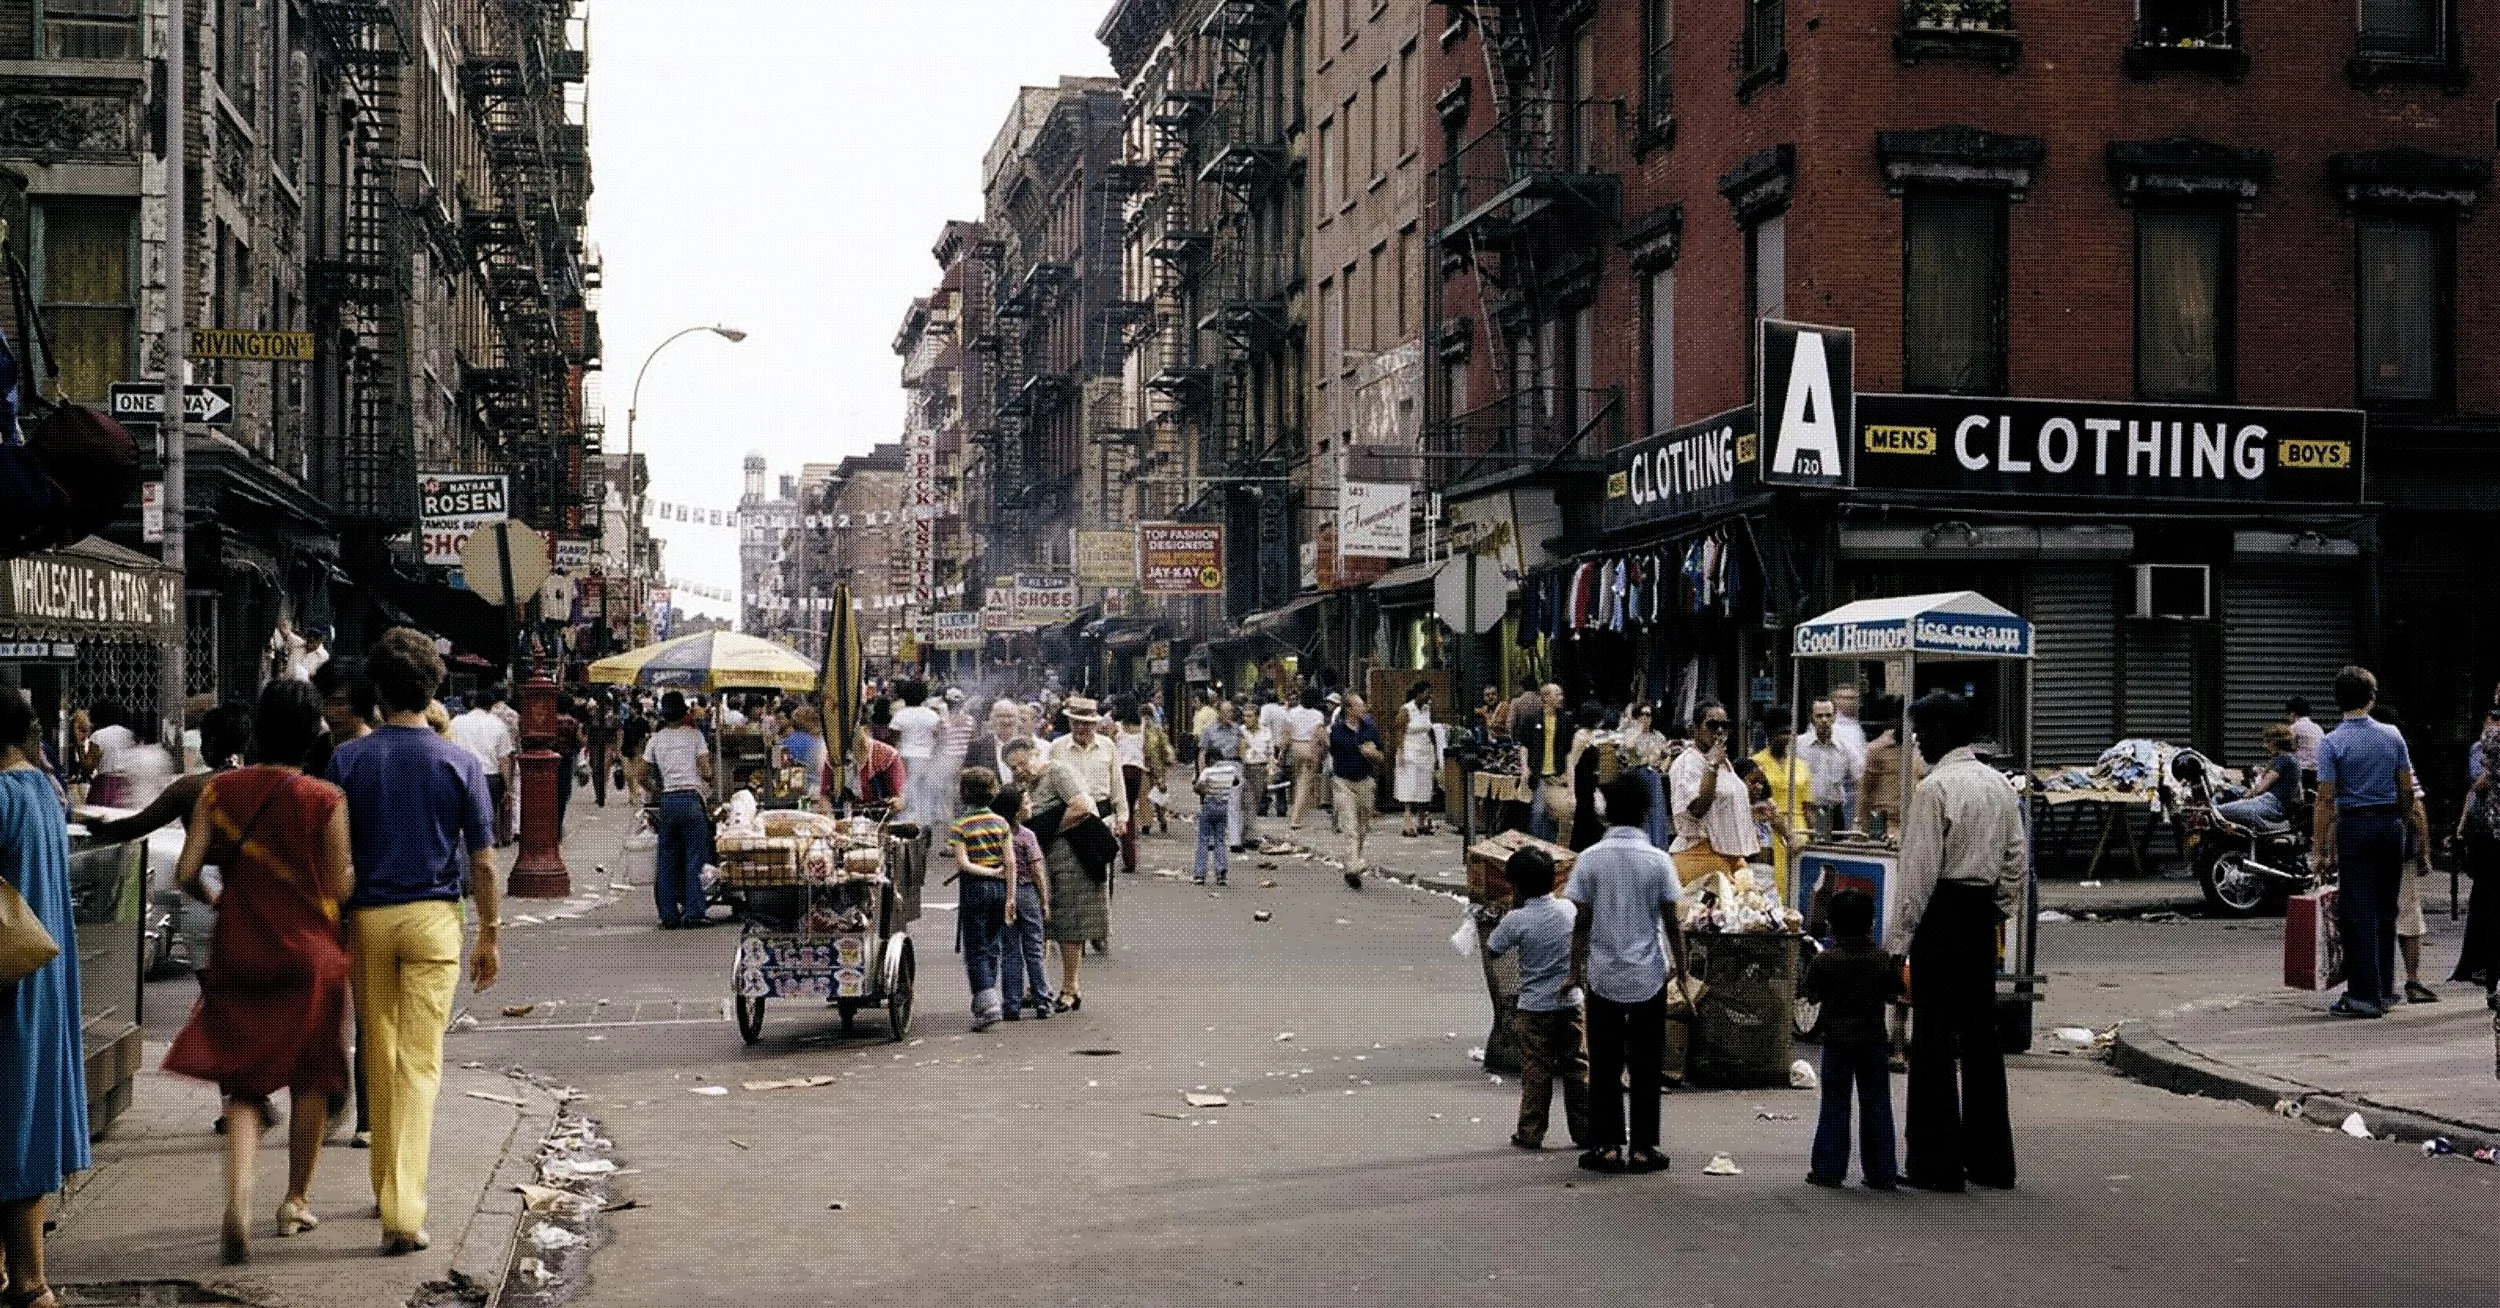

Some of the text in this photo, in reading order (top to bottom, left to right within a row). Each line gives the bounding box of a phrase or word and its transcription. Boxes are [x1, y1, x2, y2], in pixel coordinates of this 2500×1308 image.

[192, 331, 299, 356] RIVINGTON
[121, 396, 156, 410] ONE
[1772, 331, 1842, 476] A
[1872, 430, 1928, 450] MENS
[1954, 414, 2269, 480] CLOTHING
[2288, 444, 2342, 464] BOYS
[1631, 426, 1734, 506] CLOTHING
[1798, 458, 1820, 475] 120
[449, 481, 496, 493] NATHAN
[425, 492, 502, 514] ROSEN
[422, 520, 460, 530] AMOUS
[916, 453, 931, 601] BECKNSTEIN
[1145, 529, 1219, 540] TOP FASHION
[422, 533, 469, 556] SHO
[1148, 540, 1214, 550] DESIGNERS
[1147, 566, 1200, 579] JAY-KAY
[9, 557, 95, 620] WHOLESALE
[110, 569, 153, 623] RETAIL
[1018, 591, 1072, 607] SHOES
[1799, 622, 1907, 651] Good Humor
[1916, 618, 2020, 646] ice cream
